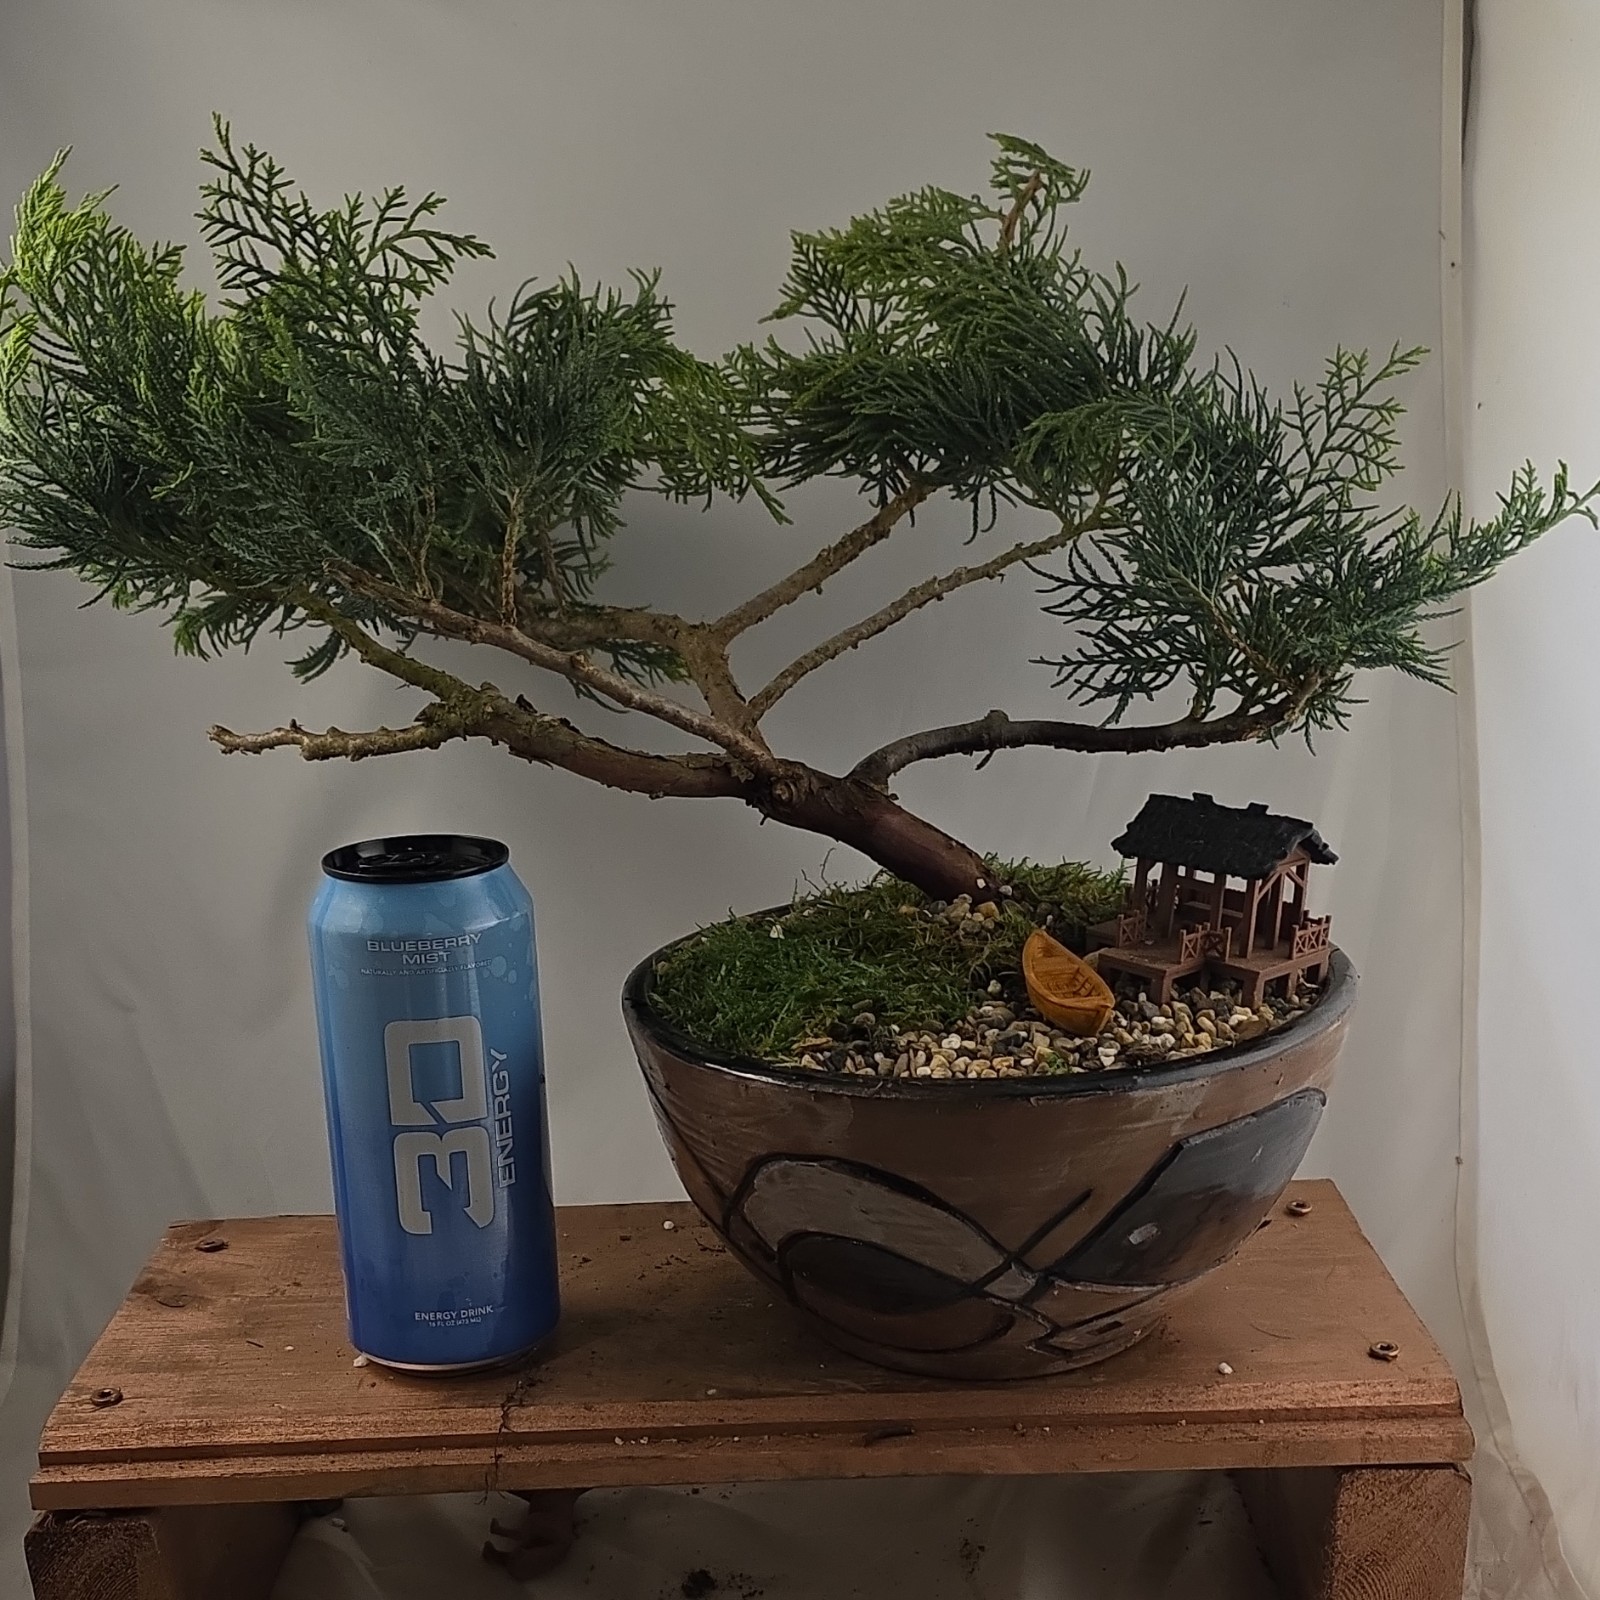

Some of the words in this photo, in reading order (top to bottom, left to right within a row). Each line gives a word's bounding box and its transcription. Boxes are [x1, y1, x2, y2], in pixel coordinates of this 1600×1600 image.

[366, 933, 482, 952] BLUEBERRY
[402, 951, 451, 965] MIST
[490, 1048, 516, 1188] ENERGY
[414, 1311, 458, 1321] ENERGY
[460, 1304, 494, 1318] DRINK
